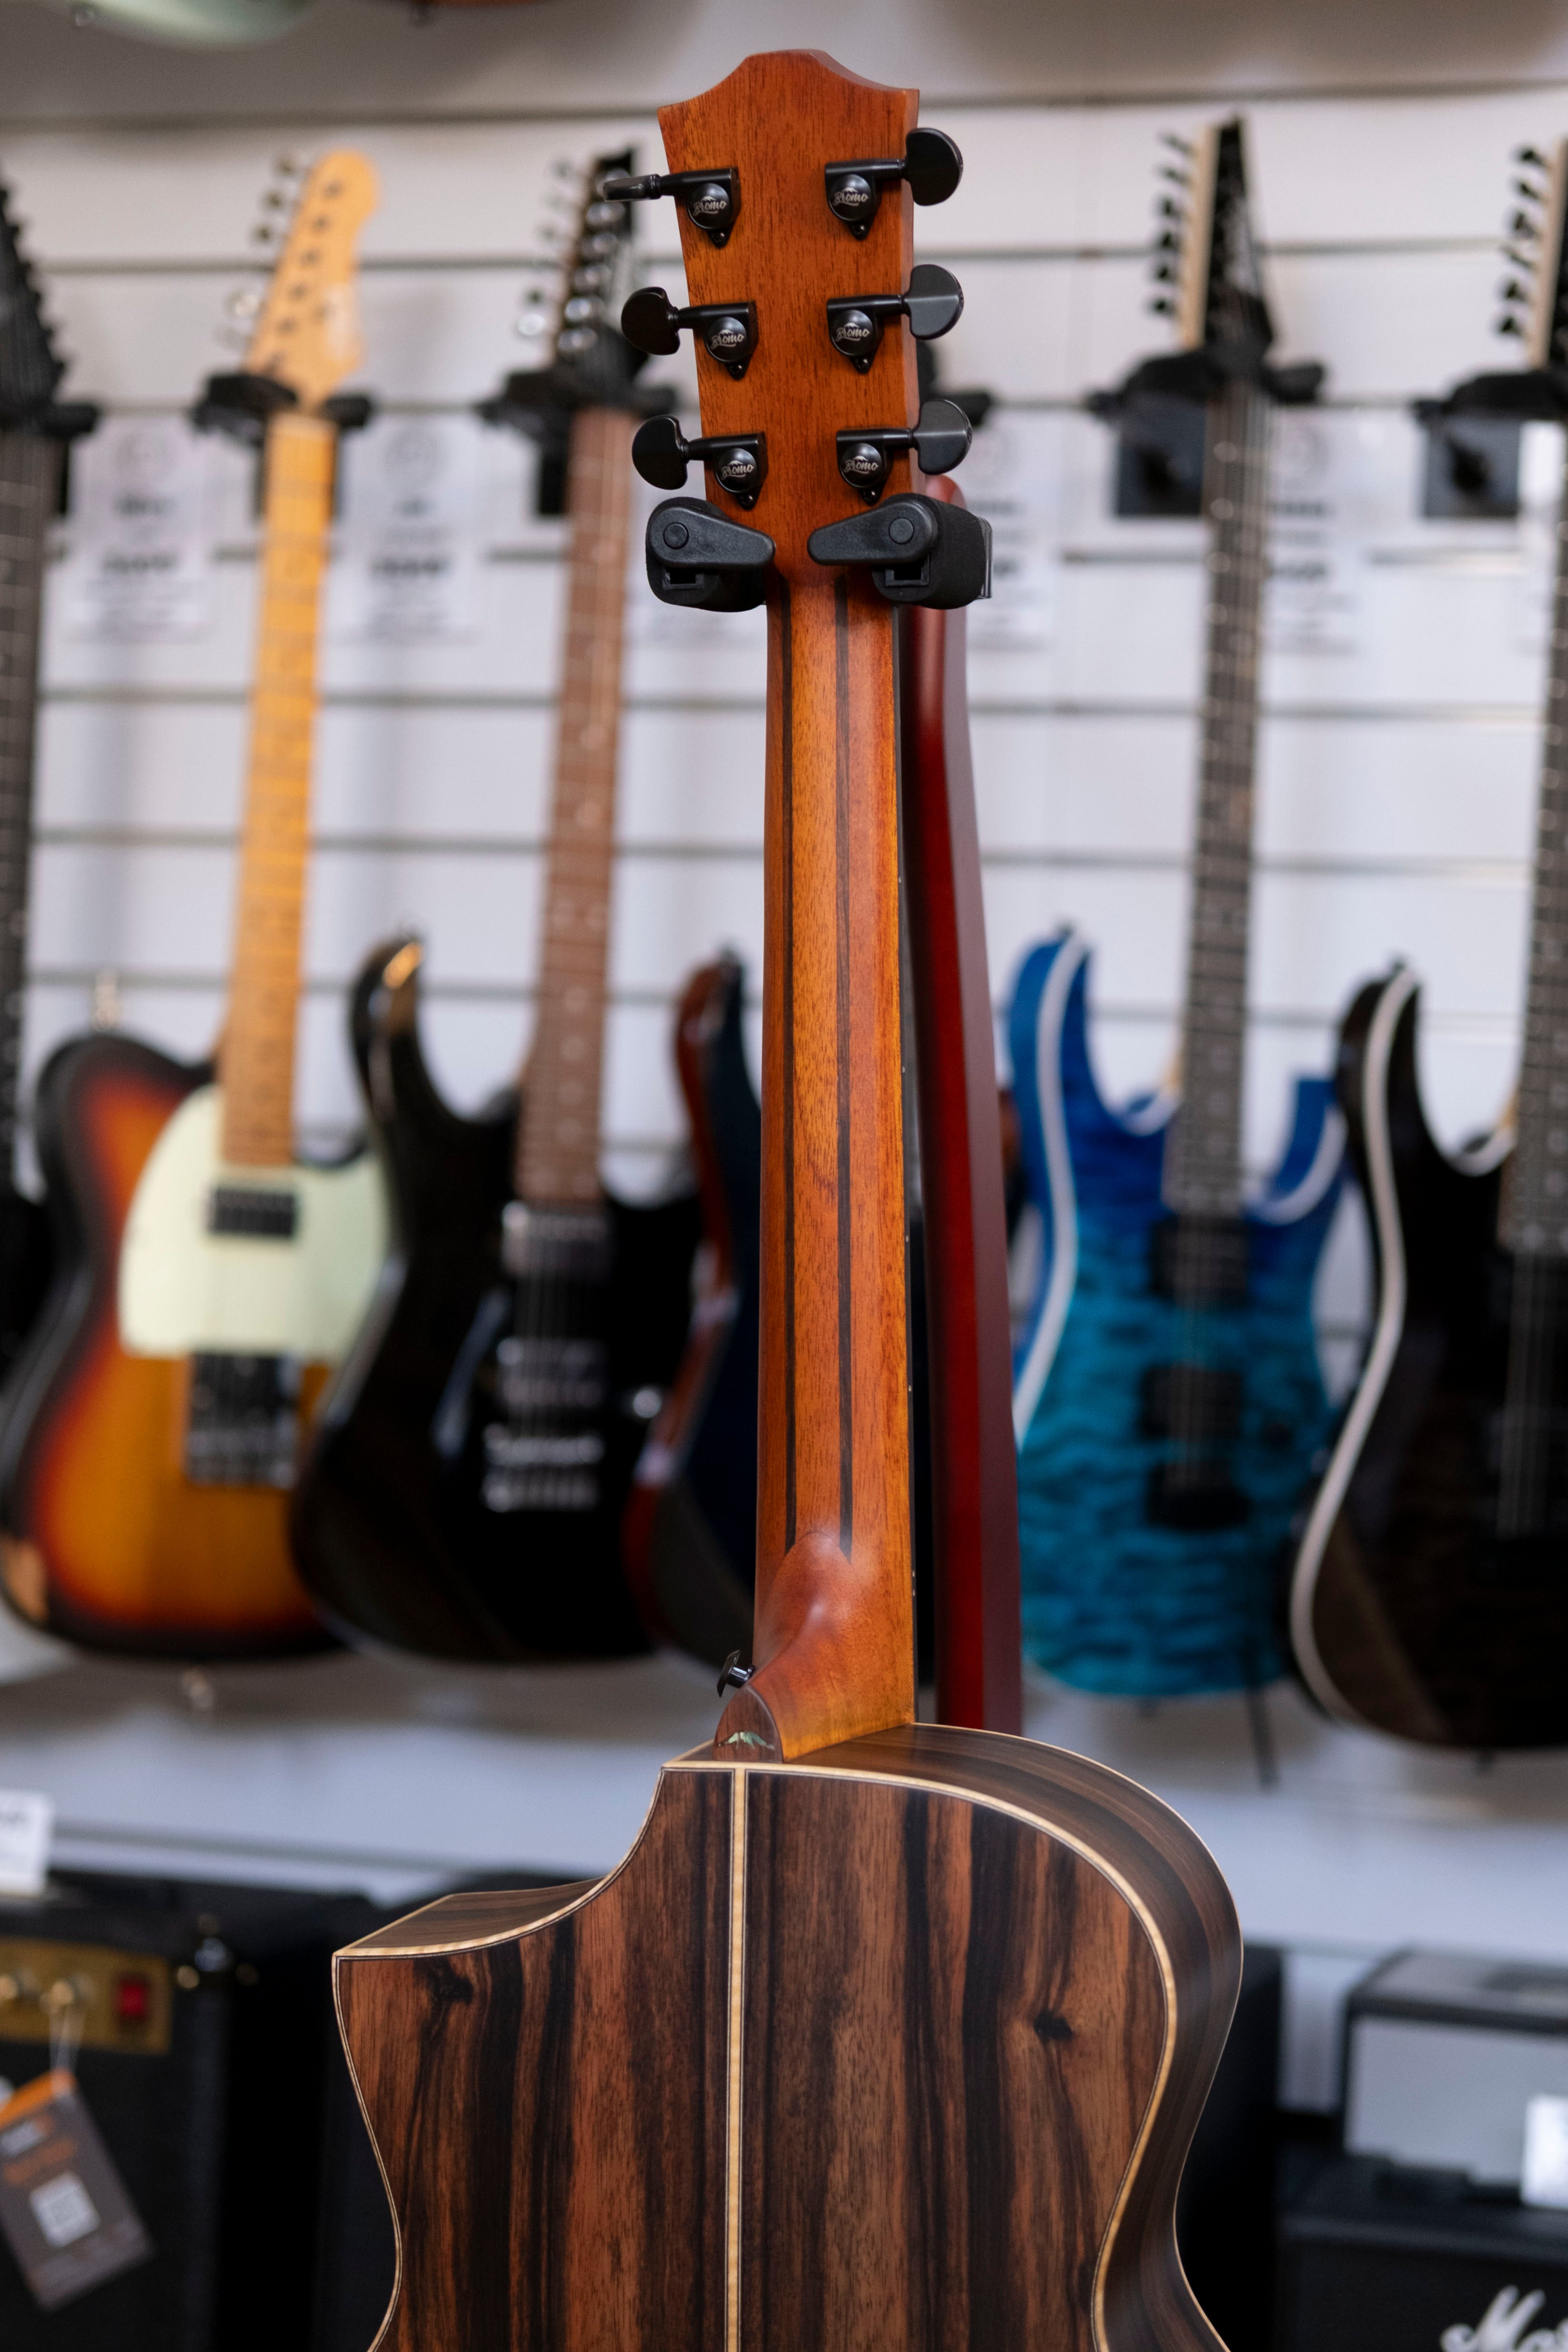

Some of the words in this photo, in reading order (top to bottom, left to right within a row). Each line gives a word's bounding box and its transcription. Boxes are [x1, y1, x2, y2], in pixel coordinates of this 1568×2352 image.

[833, 191, 869, 206] Bromo
[693, 201, 727, 216] Bromo
[710, 334, 745, 350] Bromo
[835, 328, 870, 342] Bromo
[721, 464, 754, 480] Bromo
[844, 460, 879, 474] Bromo
